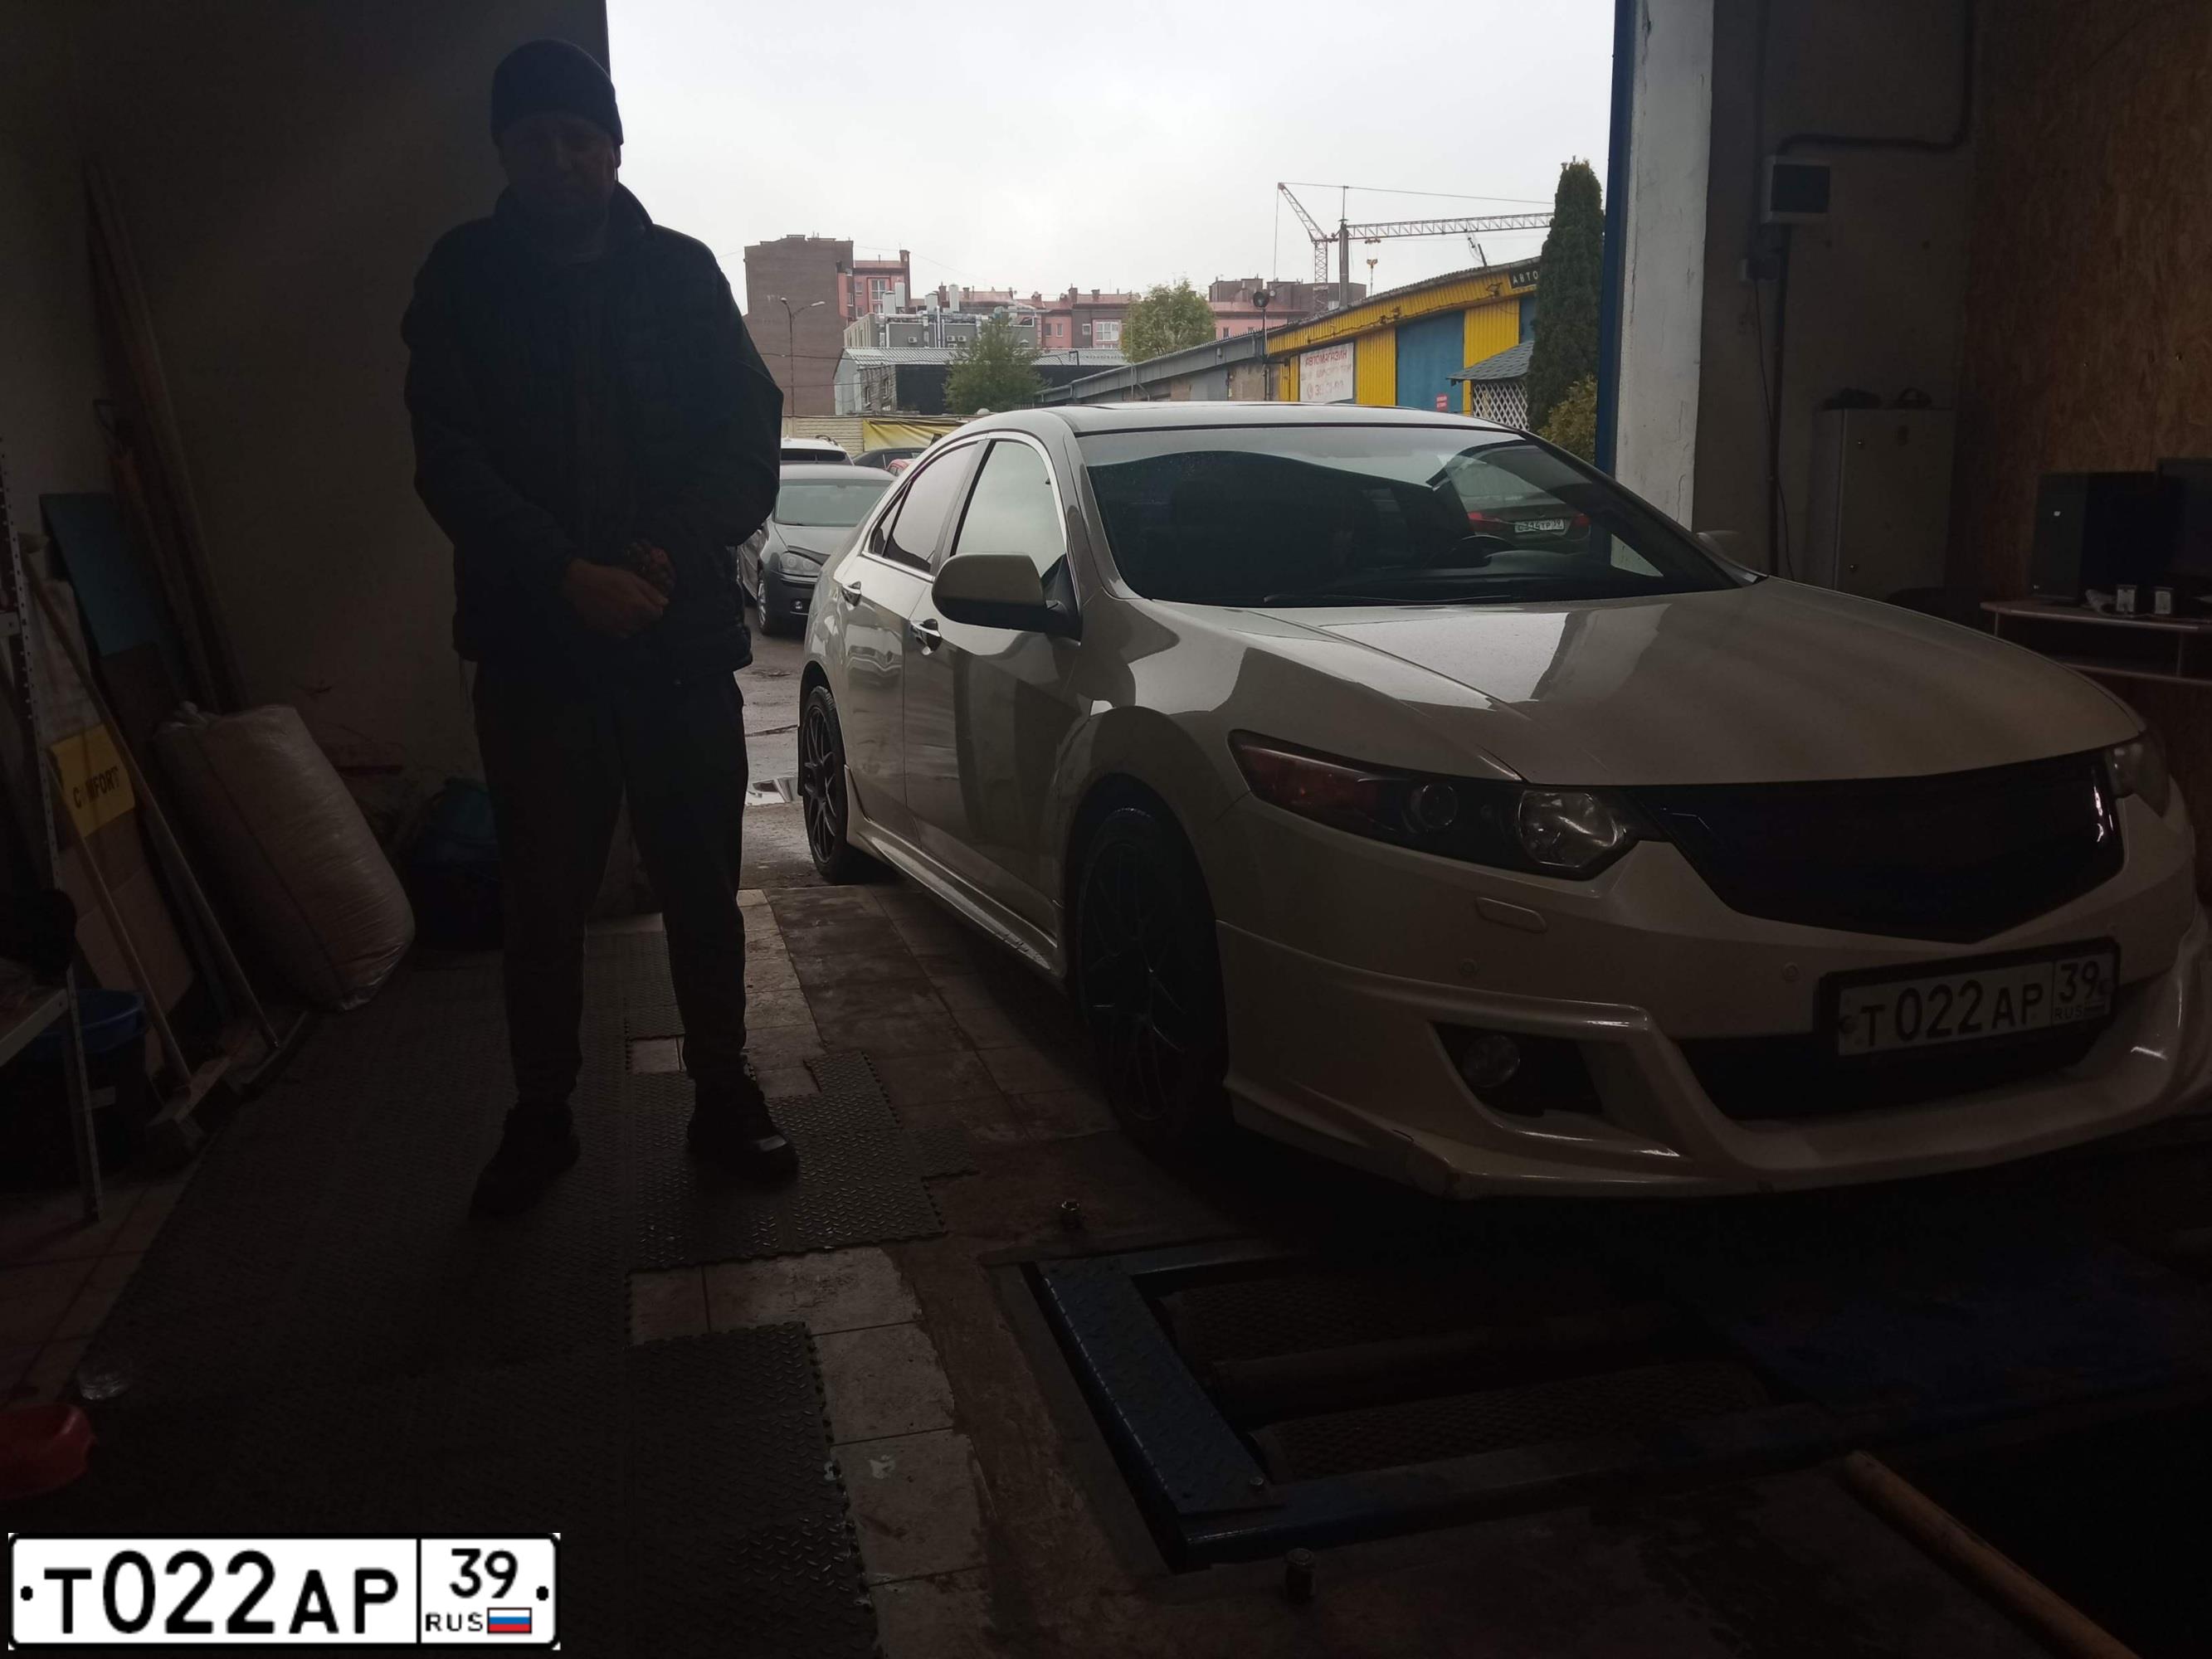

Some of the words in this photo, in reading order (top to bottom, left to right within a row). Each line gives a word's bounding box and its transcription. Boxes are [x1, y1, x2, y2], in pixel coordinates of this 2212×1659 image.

[1513, 270, 1538, 285] АВТО
[1305, 349, 1347, 367] АВТОМАГАЗИН
[73, 766, 119, 810] CMFORT
[1861, 980, 2044, 1047] Т022АР
[2059, 961, 2100, 1002] 39
[2054, 1005, 2083, 1019] RUS
